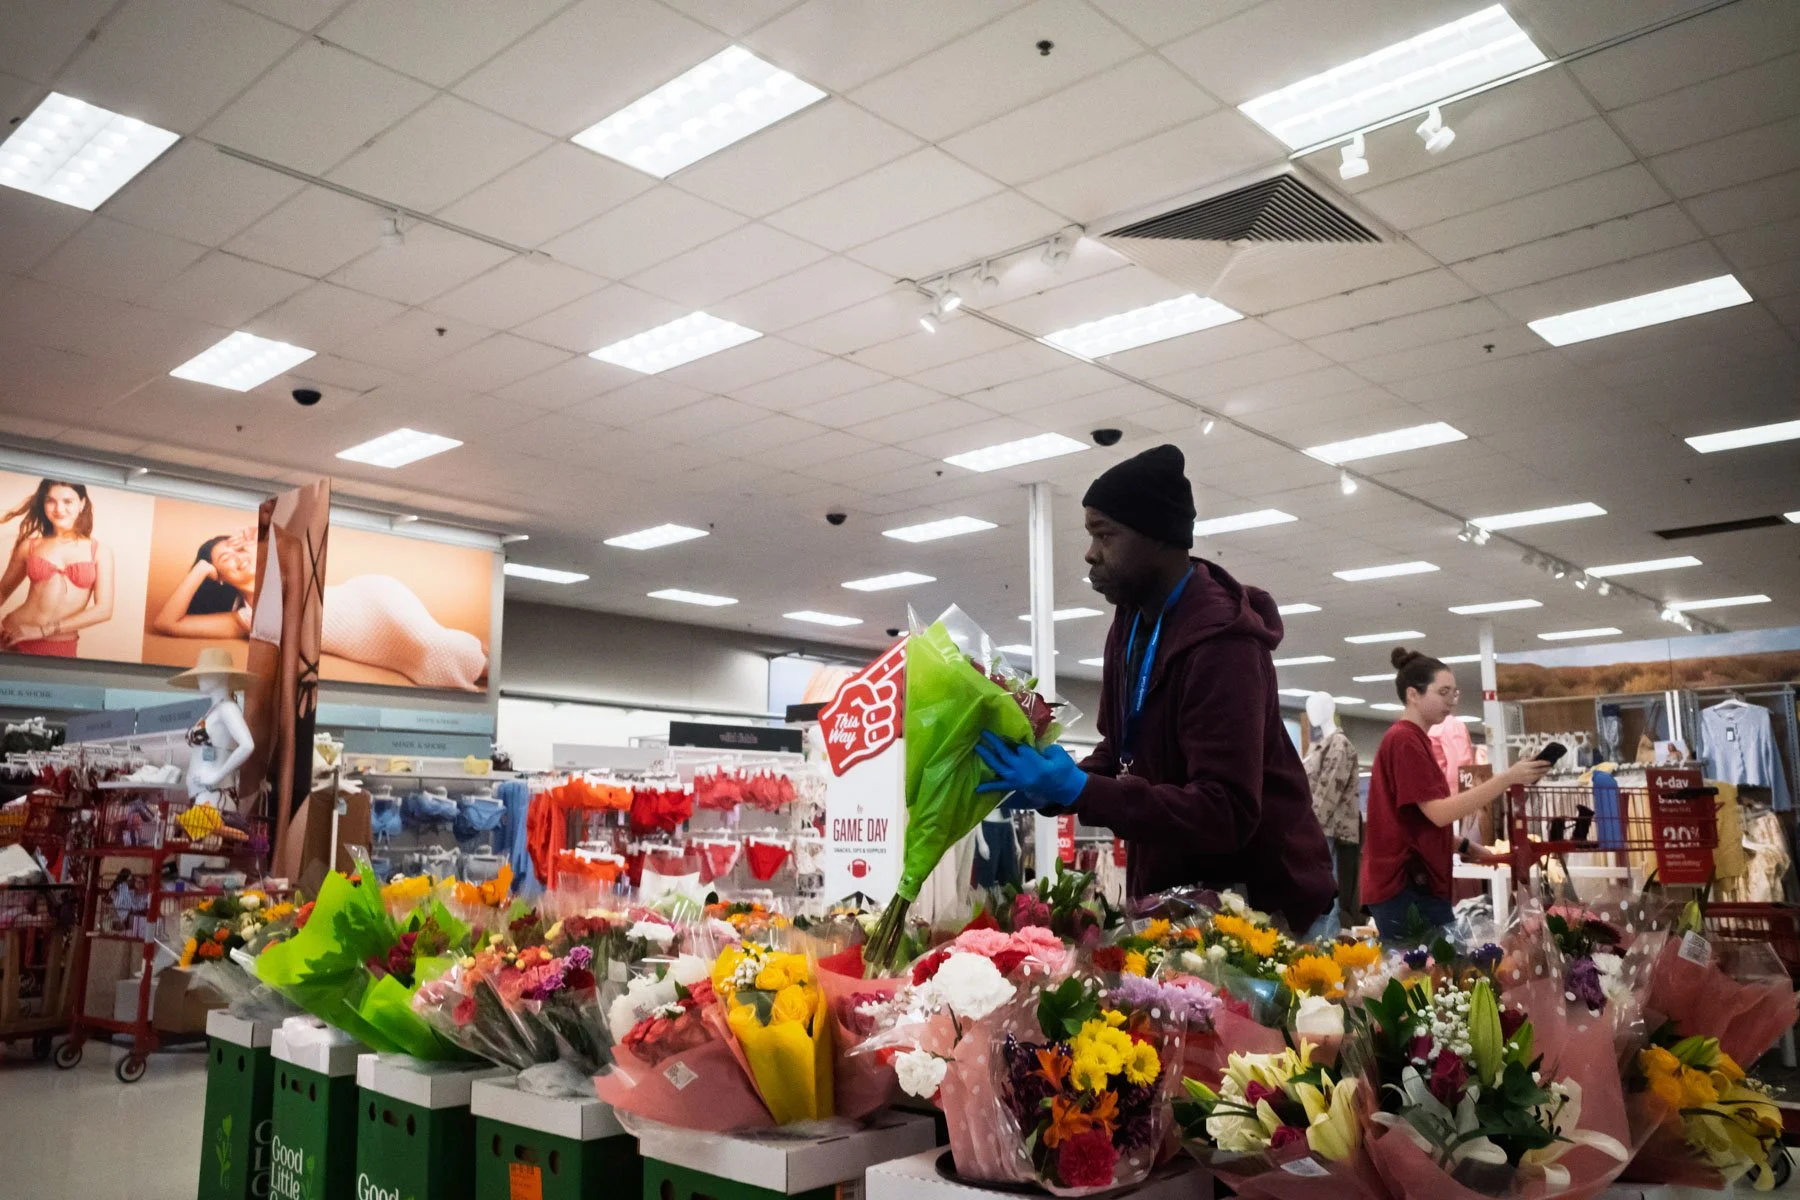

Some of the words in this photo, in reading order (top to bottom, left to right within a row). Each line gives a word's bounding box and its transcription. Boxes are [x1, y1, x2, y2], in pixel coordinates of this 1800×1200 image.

[835, 713, 860, 730] This
[829, 729, 857, 750] Way
[1656, 776, 1689, 788] 4-day
[833, 818, 864, 842] GAME
[867, 818, 888, 842] DAY
[272, 1135, 304, 1175] Good
[271, 1161, 300, 1200] Little
